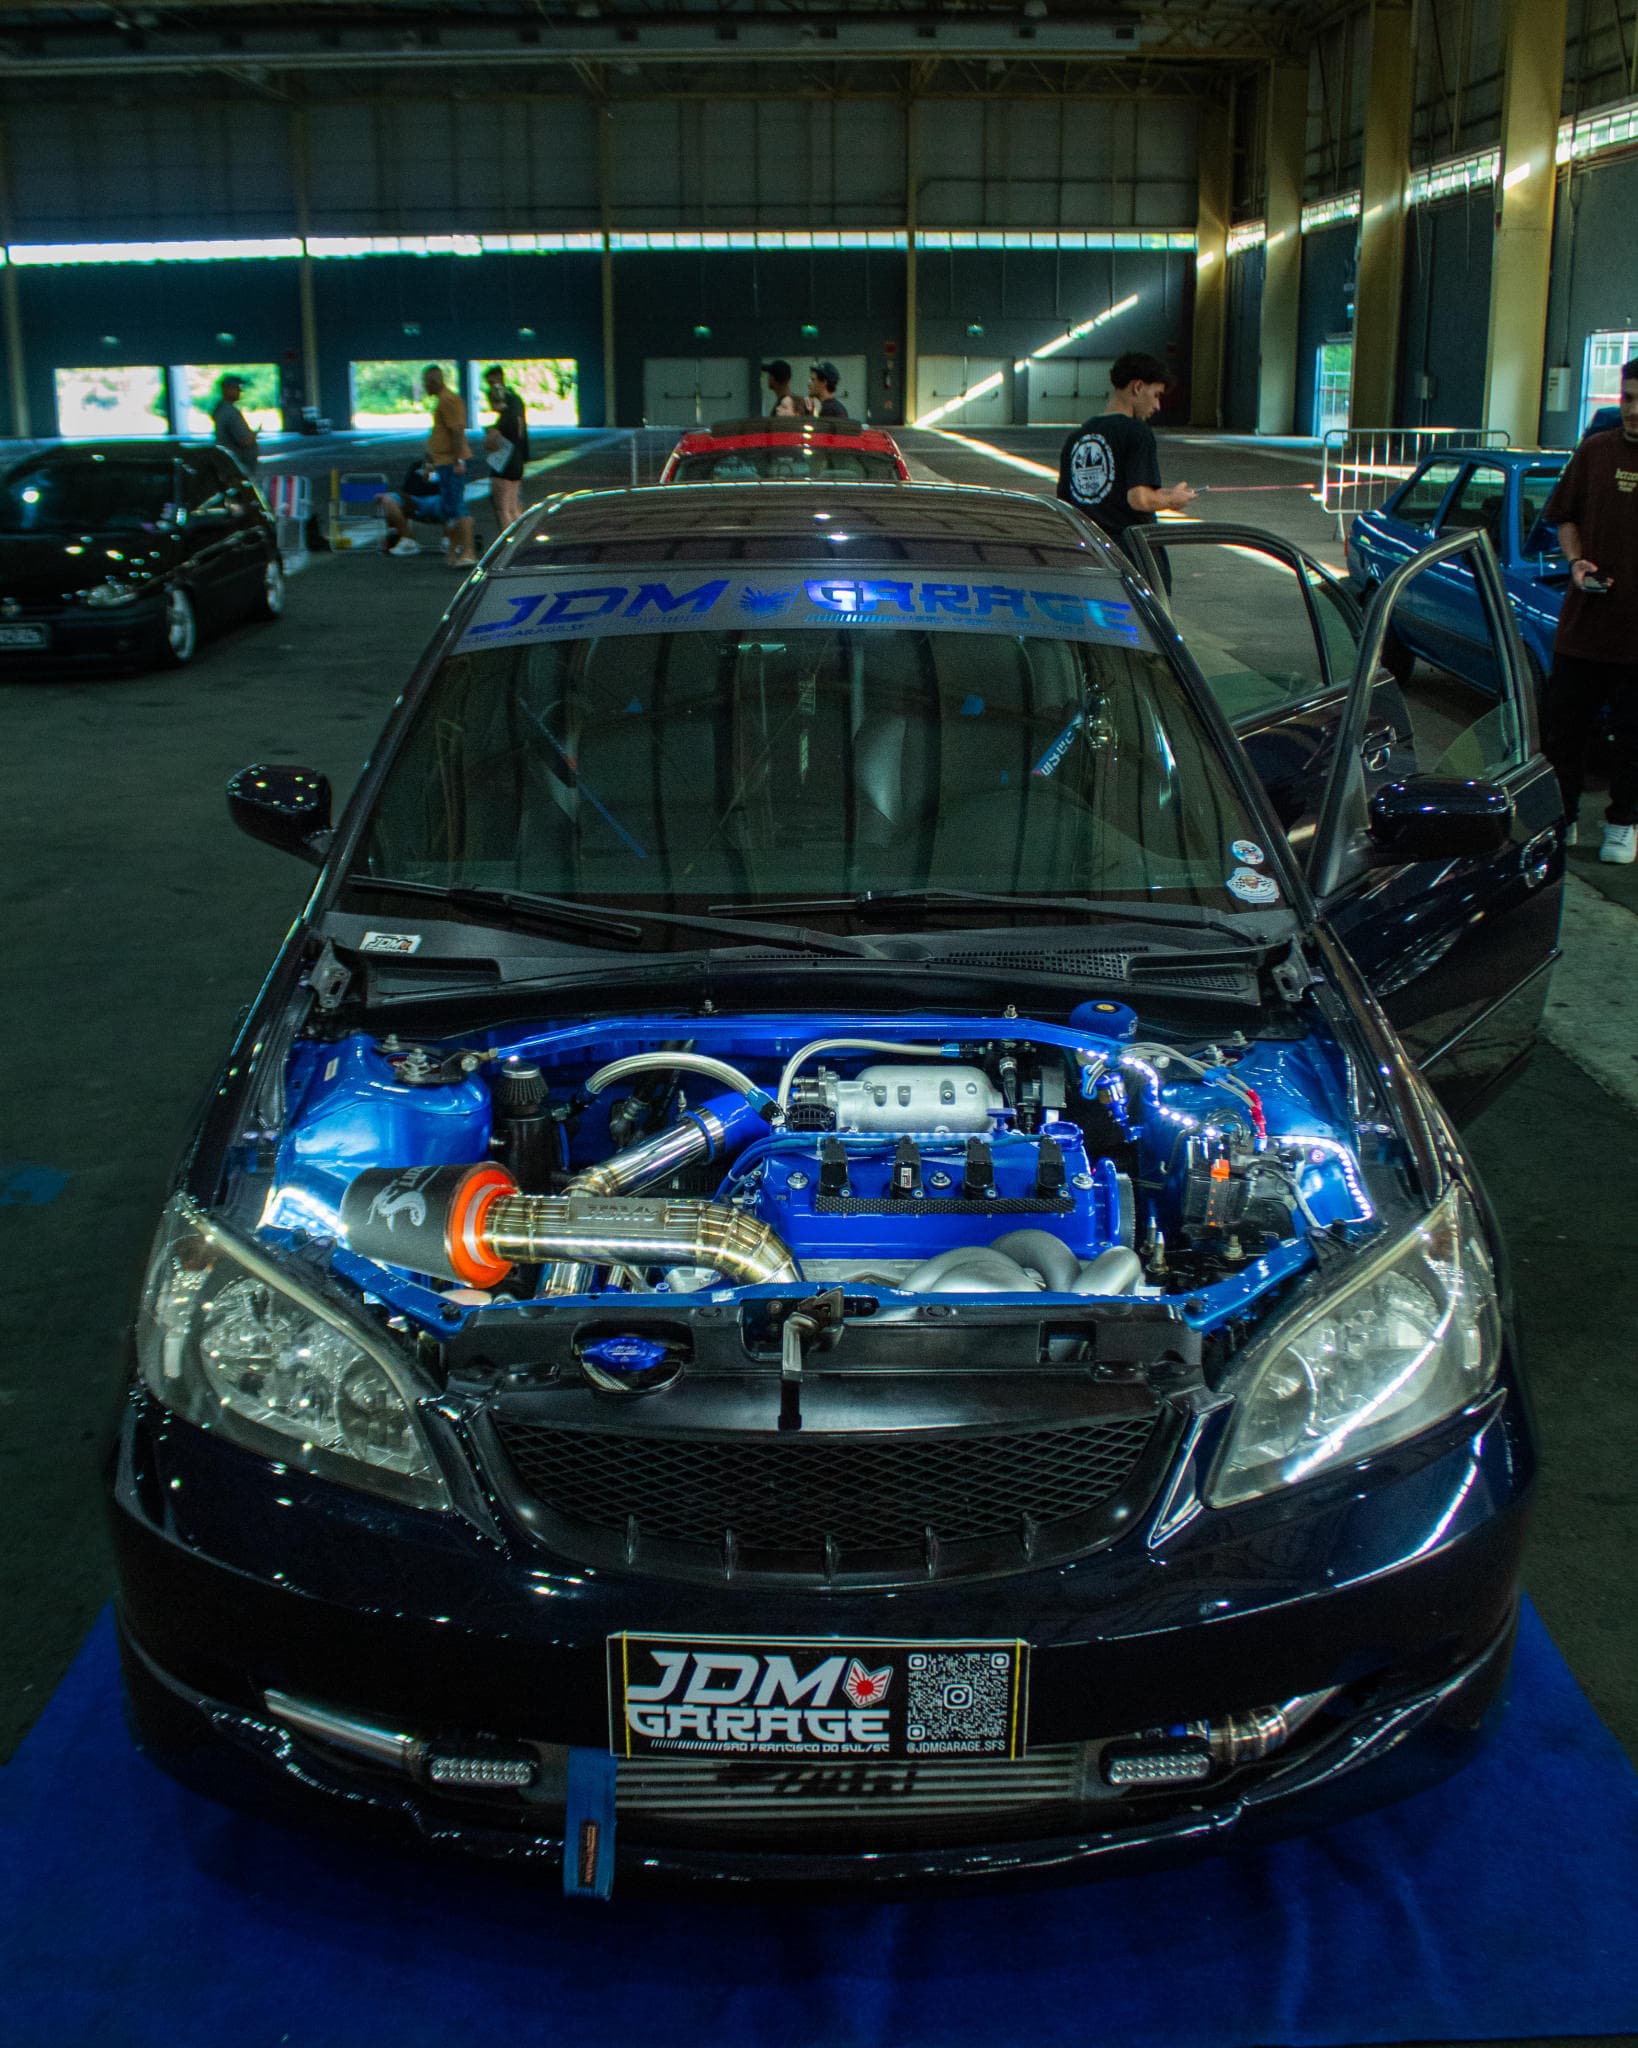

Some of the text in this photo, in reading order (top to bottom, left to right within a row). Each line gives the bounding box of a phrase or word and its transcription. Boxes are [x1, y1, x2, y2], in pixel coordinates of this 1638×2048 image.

[467, 580, 731, 636] JDM
[803, 578, 1138, 634] GARAGE
[367, 935, 402, 949] JDM
[626, 1650, 848, 1706] JDM
[628, 1703, 890, 1742] GARAGE
[750, 1743, 820, 1753] FRANCISCO
[822, 1743, 839, 1753] DO
[840, 1743, 890, 1753] SUL/SC
[906, 1740, 1006, 1754] @JDMGARAGE.SFS
